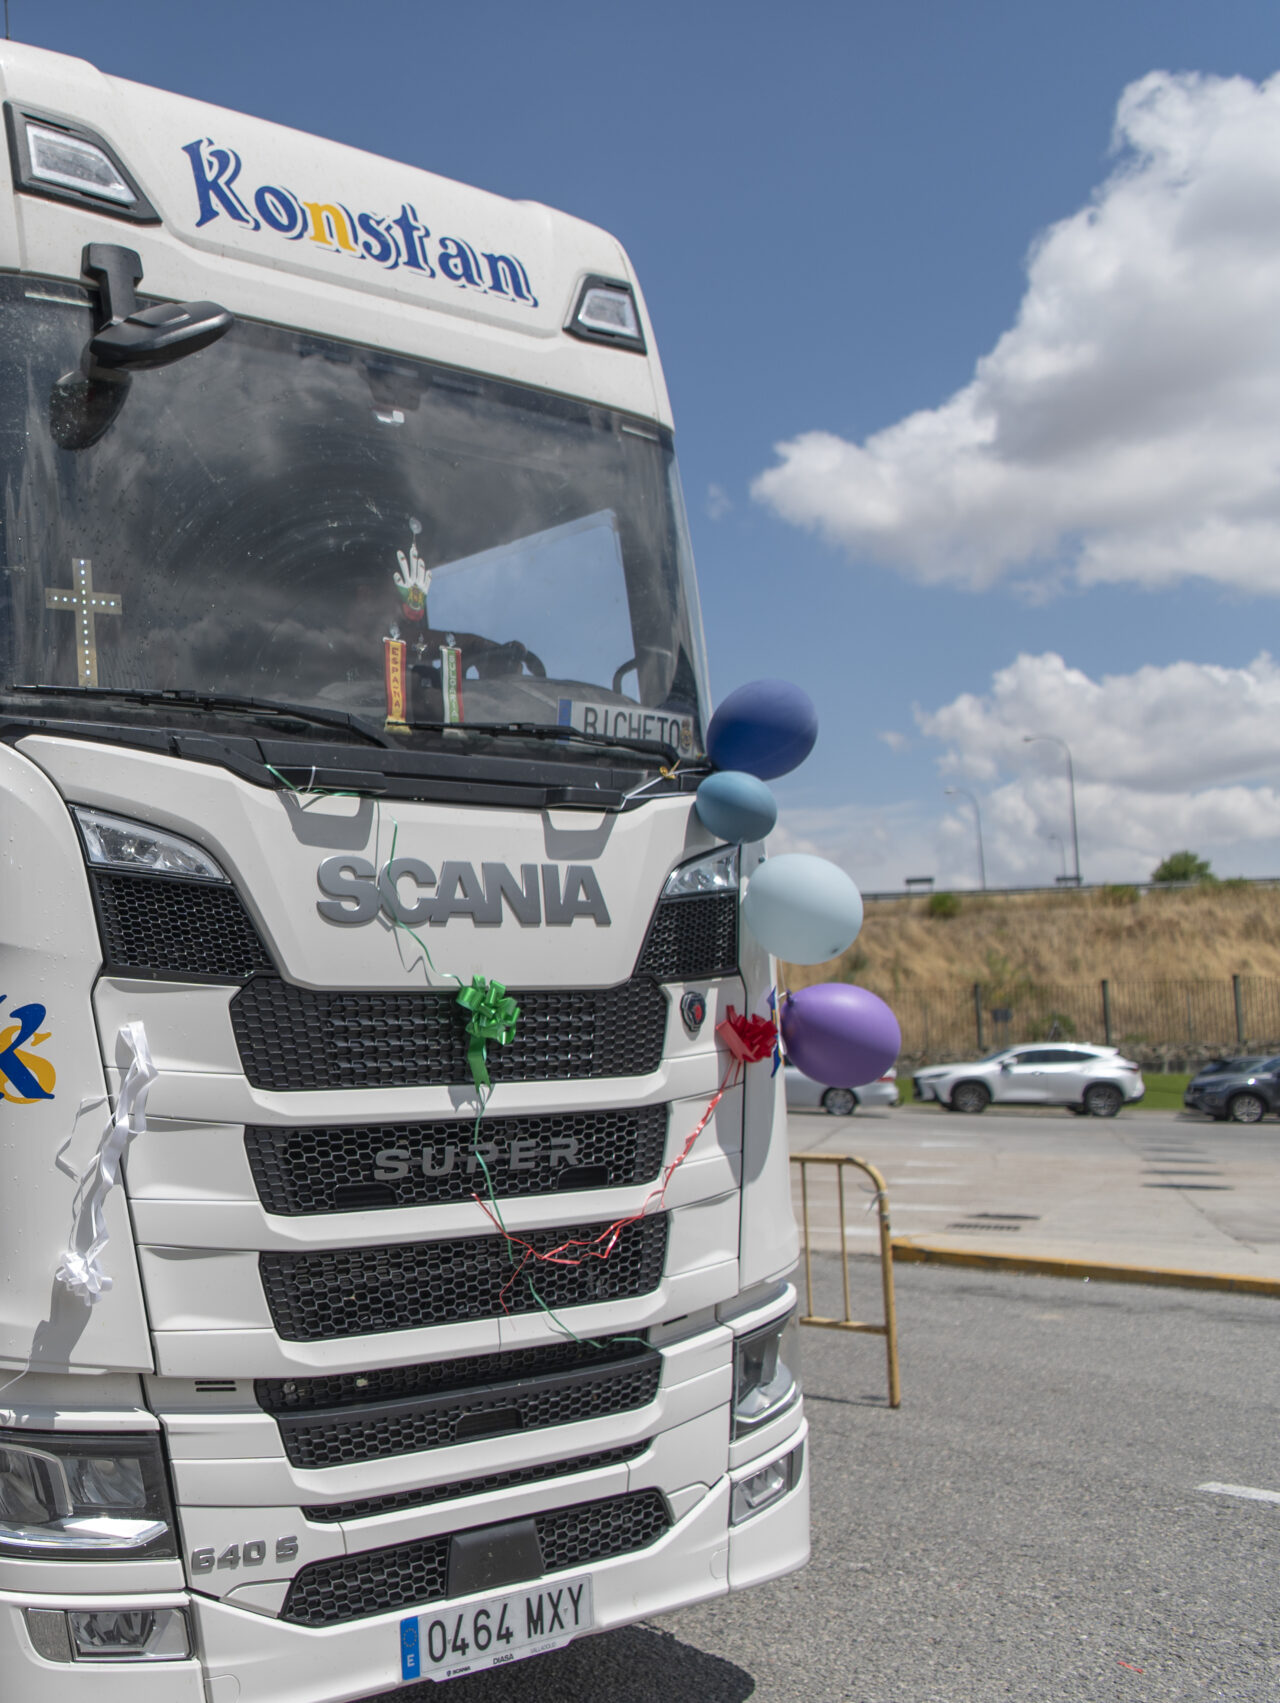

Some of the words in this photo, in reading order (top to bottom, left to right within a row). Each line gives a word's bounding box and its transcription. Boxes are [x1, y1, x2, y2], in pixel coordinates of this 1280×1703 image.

[181, 137, 539, 308] Konstan
[316, 855, 613, 927] SCANIA
[374, 1138, 580, 1181] SUPER
[191, 1540, 266, 1573] 640
[276, 1535, 299, 1562] S
[428, 1603, 514, 1663] 0464
[526, 1583, 584, 1639] MXY
[407, 1654, 415, 1668] E
[493, 1653, 514, 1665] DIASA
